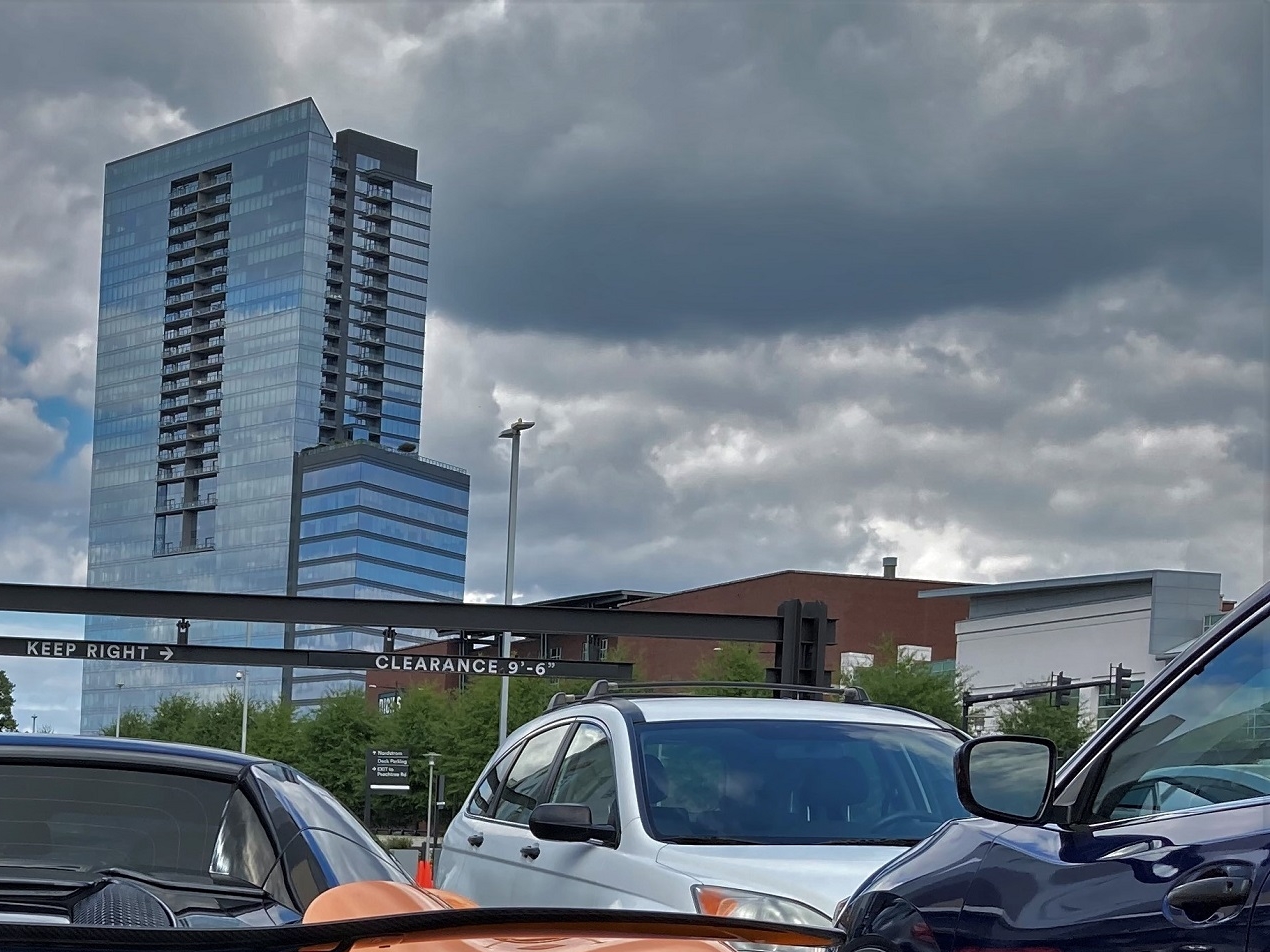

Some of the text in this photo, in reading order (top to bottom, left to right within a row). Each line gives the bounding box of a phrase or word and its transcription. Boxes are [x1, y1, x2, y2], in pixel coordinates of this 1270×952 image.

[27, 641, 149, 660] KEEP RIGHT
[375, 654, 498, 674] CLEARANCE
